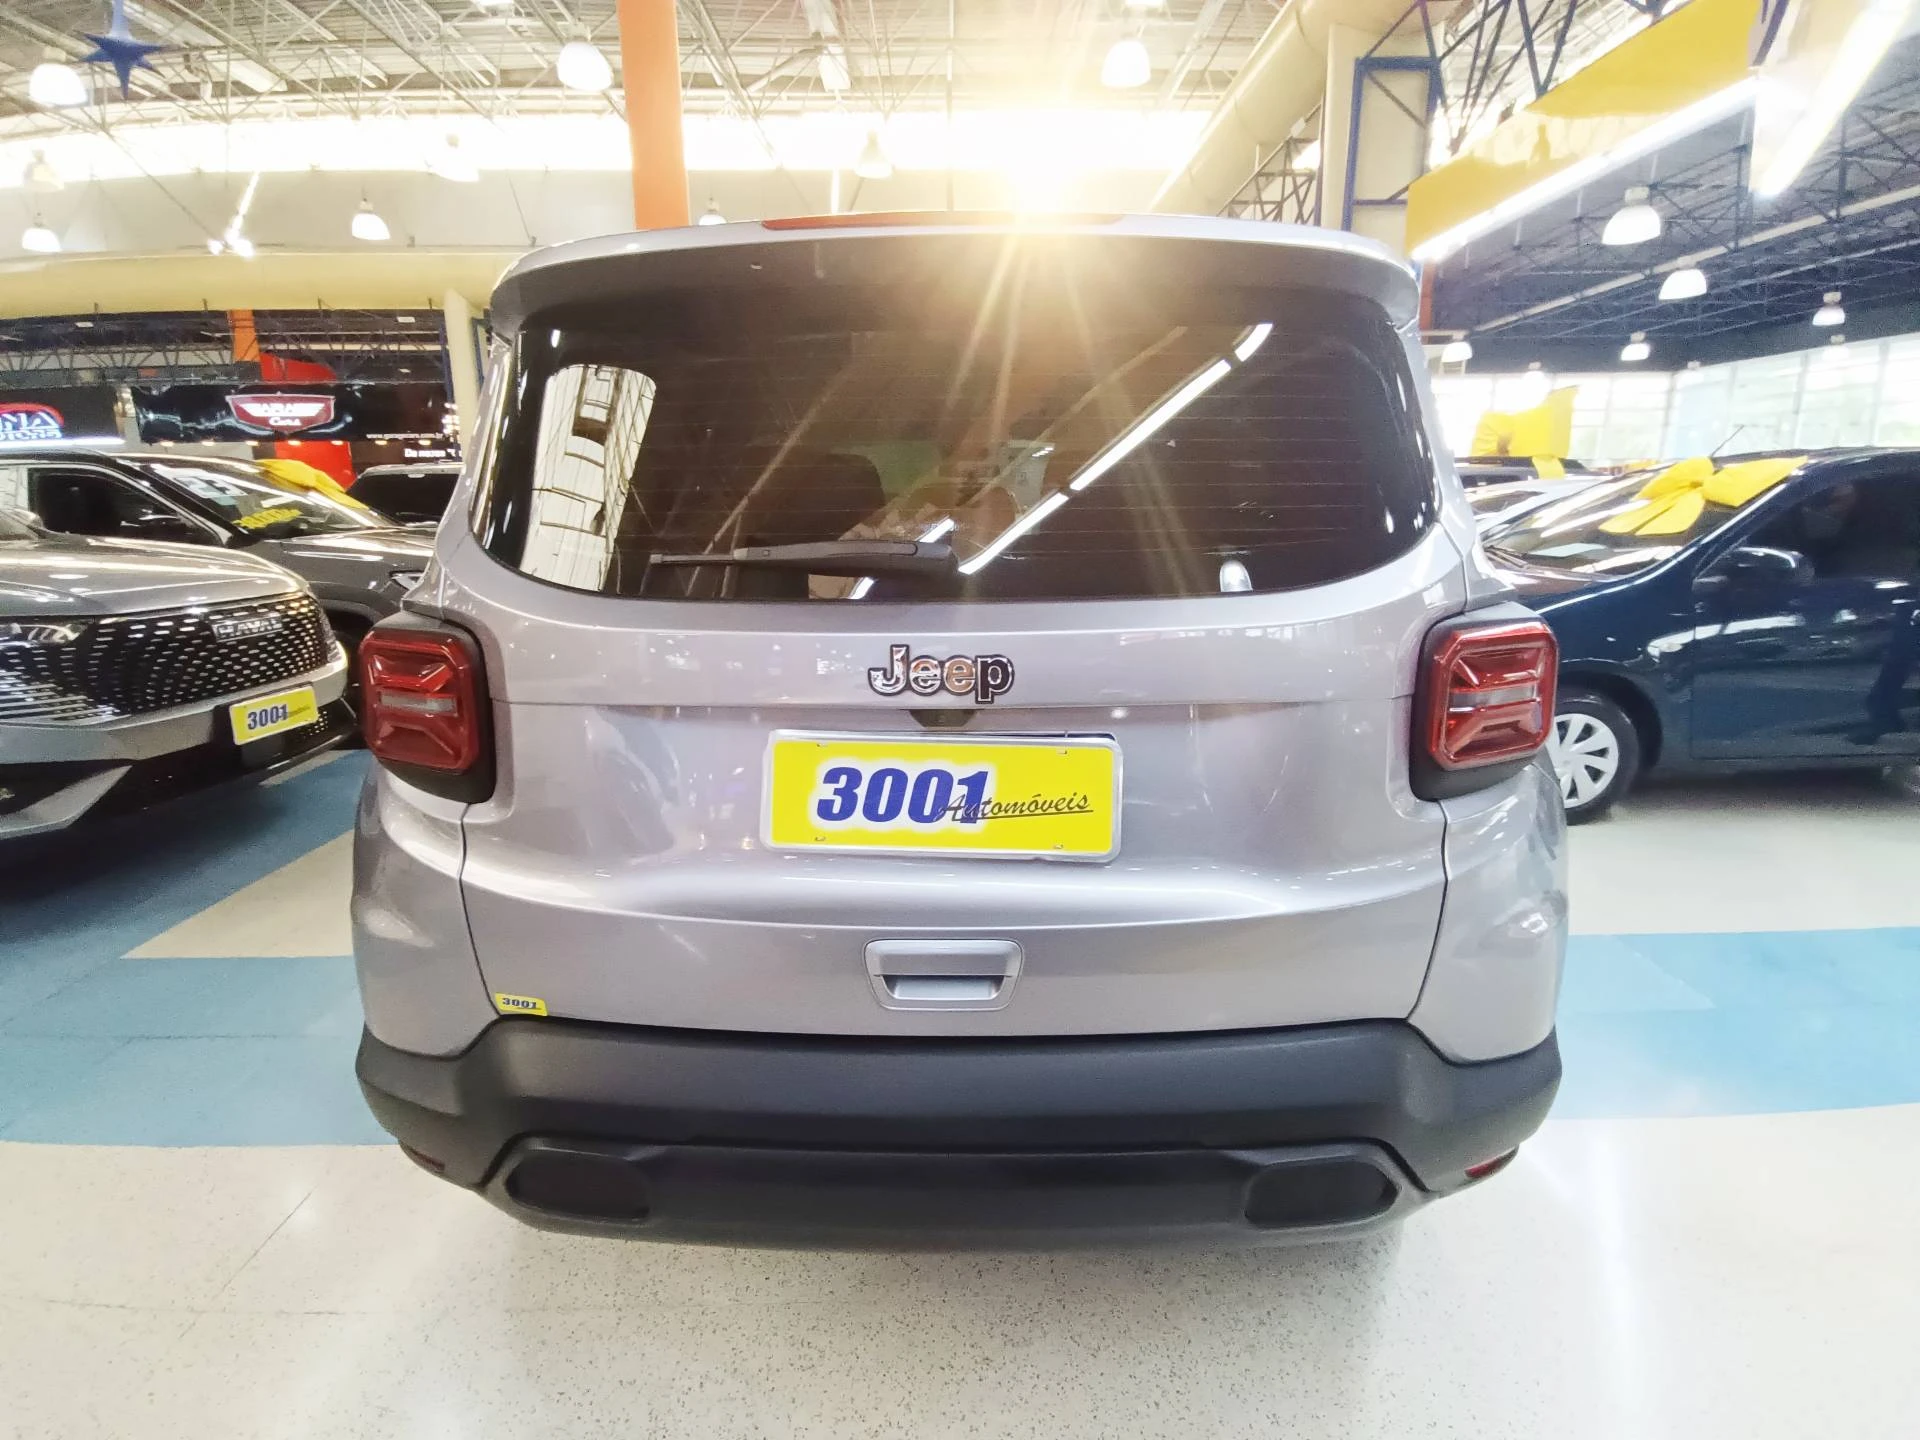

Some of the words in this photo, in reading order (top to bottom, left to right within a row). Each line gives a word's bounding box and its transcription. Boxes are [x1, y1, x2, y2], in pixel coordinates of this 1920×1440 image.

[218, 619, 282, 637] HAVAL
[868, 644, 1014, 704] Jeep
[248, 704, 288, 730] 3001
[816, 766, 989, 824] 3001
[934, 791, 1091, 822] Automóveis
[502, 998, 537, 1009] 3001
